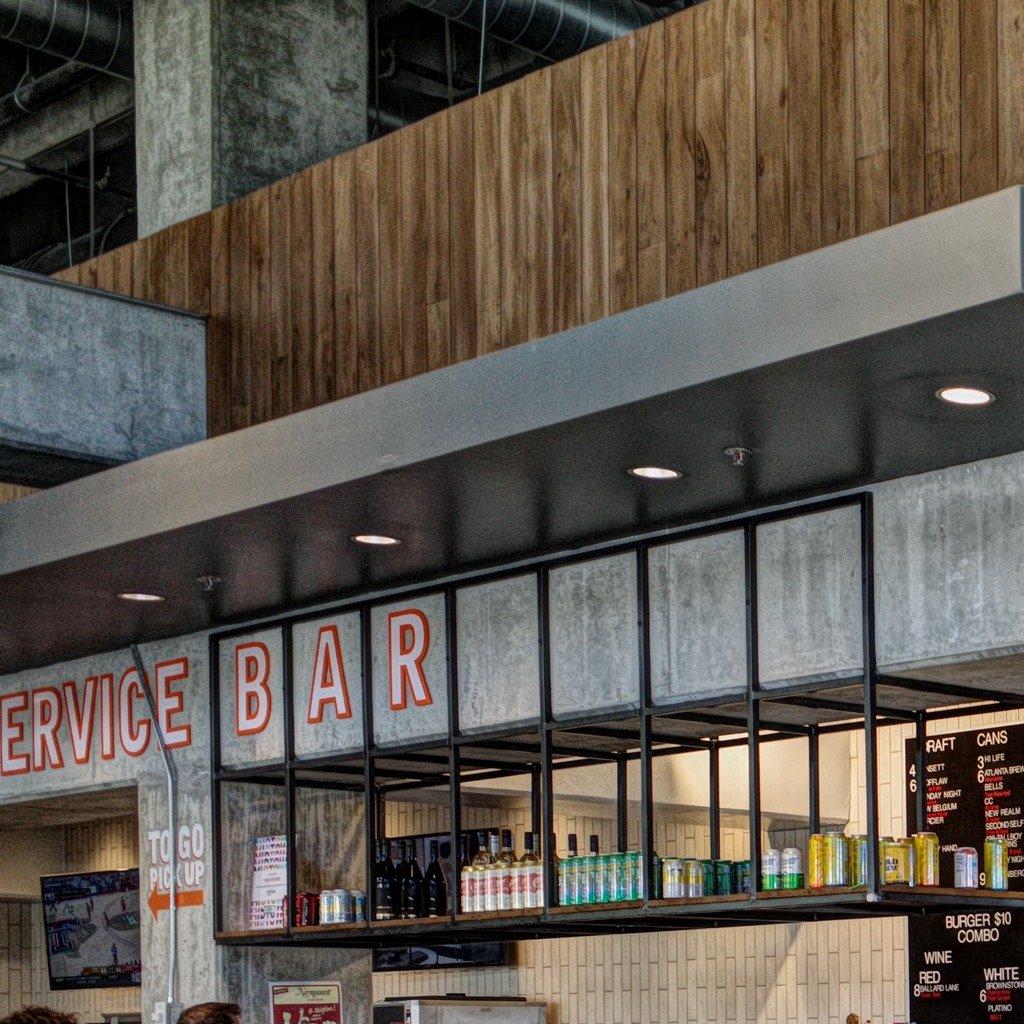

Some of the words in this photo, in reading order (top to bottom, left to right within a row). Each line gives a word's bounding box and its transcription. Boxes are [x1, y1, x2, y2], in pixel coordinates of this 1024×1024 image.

[235, 608, 433, 736] BAR
[977, 730, 1008, 746] CANS
[977, 756, 984, 769] 3
[985, 754, 991, 762] HI
[992, 753, 1005, 762] LIFE
[909, 764, 916, 777] 4
[978, 770, 984, 783] 6
[984, 767, 1009, 776] ATLANTA
[910, 780, 917, 792] 6
[984, 782, 1003, 791] BELLS
[944, 790, 961, 798] NIGHT
[933, 803, 957, 812] BELGIUM
[985, 809, 998, 818] NEW
[1001, 807, 1020, 816] REALM
[985, 821, 1010, 830] SECOND
[1010, 819, 1024, 828] SELF
[148, 829, 171, 865] TO
[178, 823, 204, 860] GO
[942, 844, 958, 853] HAND
[184, 860, 205, 887] UP
[979, 872, 985, 886] 9
[945, 913, 991, 929] BURGER
[994, 911, 1011, 926] $10
[957, 928, 999, 943] COMBO
[924, 950, 953, 964] WINE
[919, 971, 941, 984] RED
[983, 967, 1019, 981] WHITE
[913, 984, 920, 997] 8
[920, 984, 944, 993] BALLARD
[945, 983, 959, 991] LANE
[979, 989, 987, 1002] 6
[987, 1004, 1012, 1012] PLATINO
